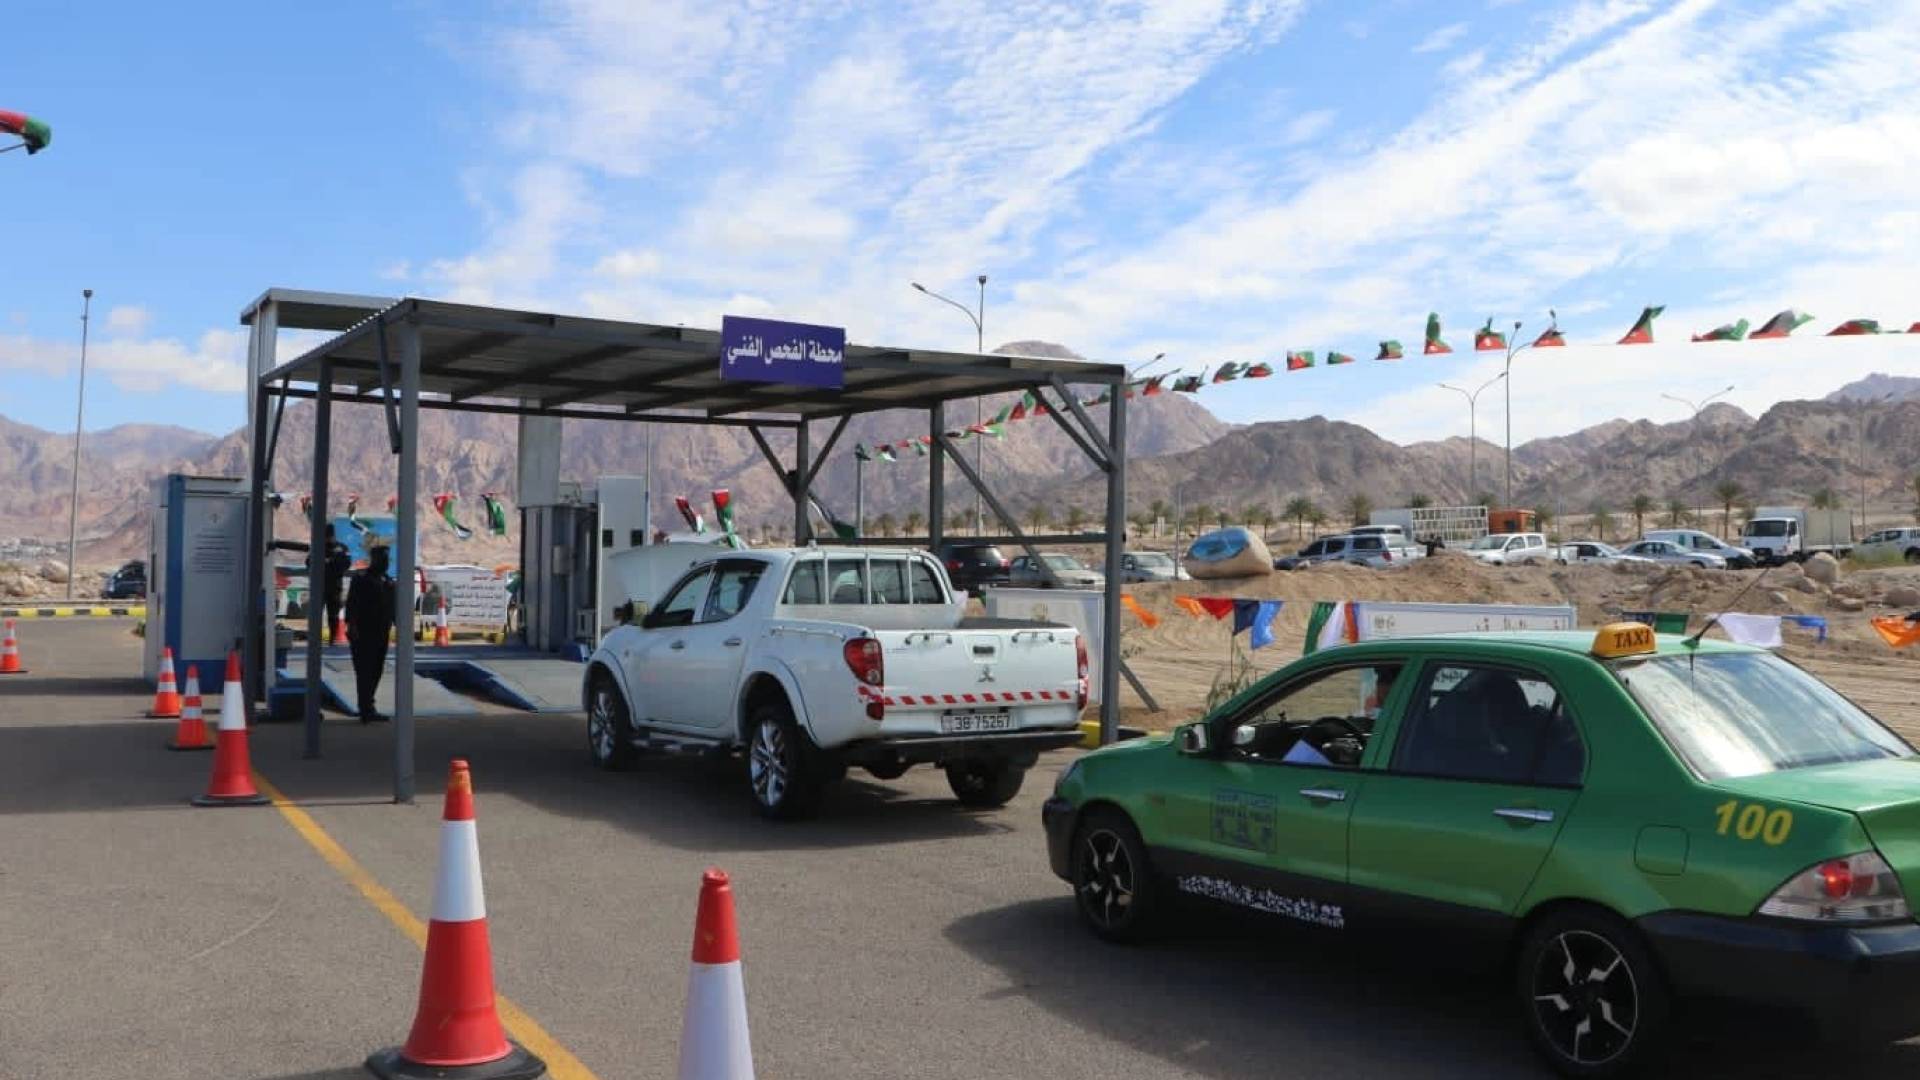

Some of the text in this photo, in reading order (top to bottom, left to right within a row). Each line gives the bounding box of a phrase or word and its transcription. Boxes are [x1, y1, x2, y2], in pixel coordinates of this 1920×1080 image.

[727, 335, 842, 365] محطة الفحص الفني
[1614, 627, 1650, 649] TAXI
[1715, 800, 1793, 845] 100
